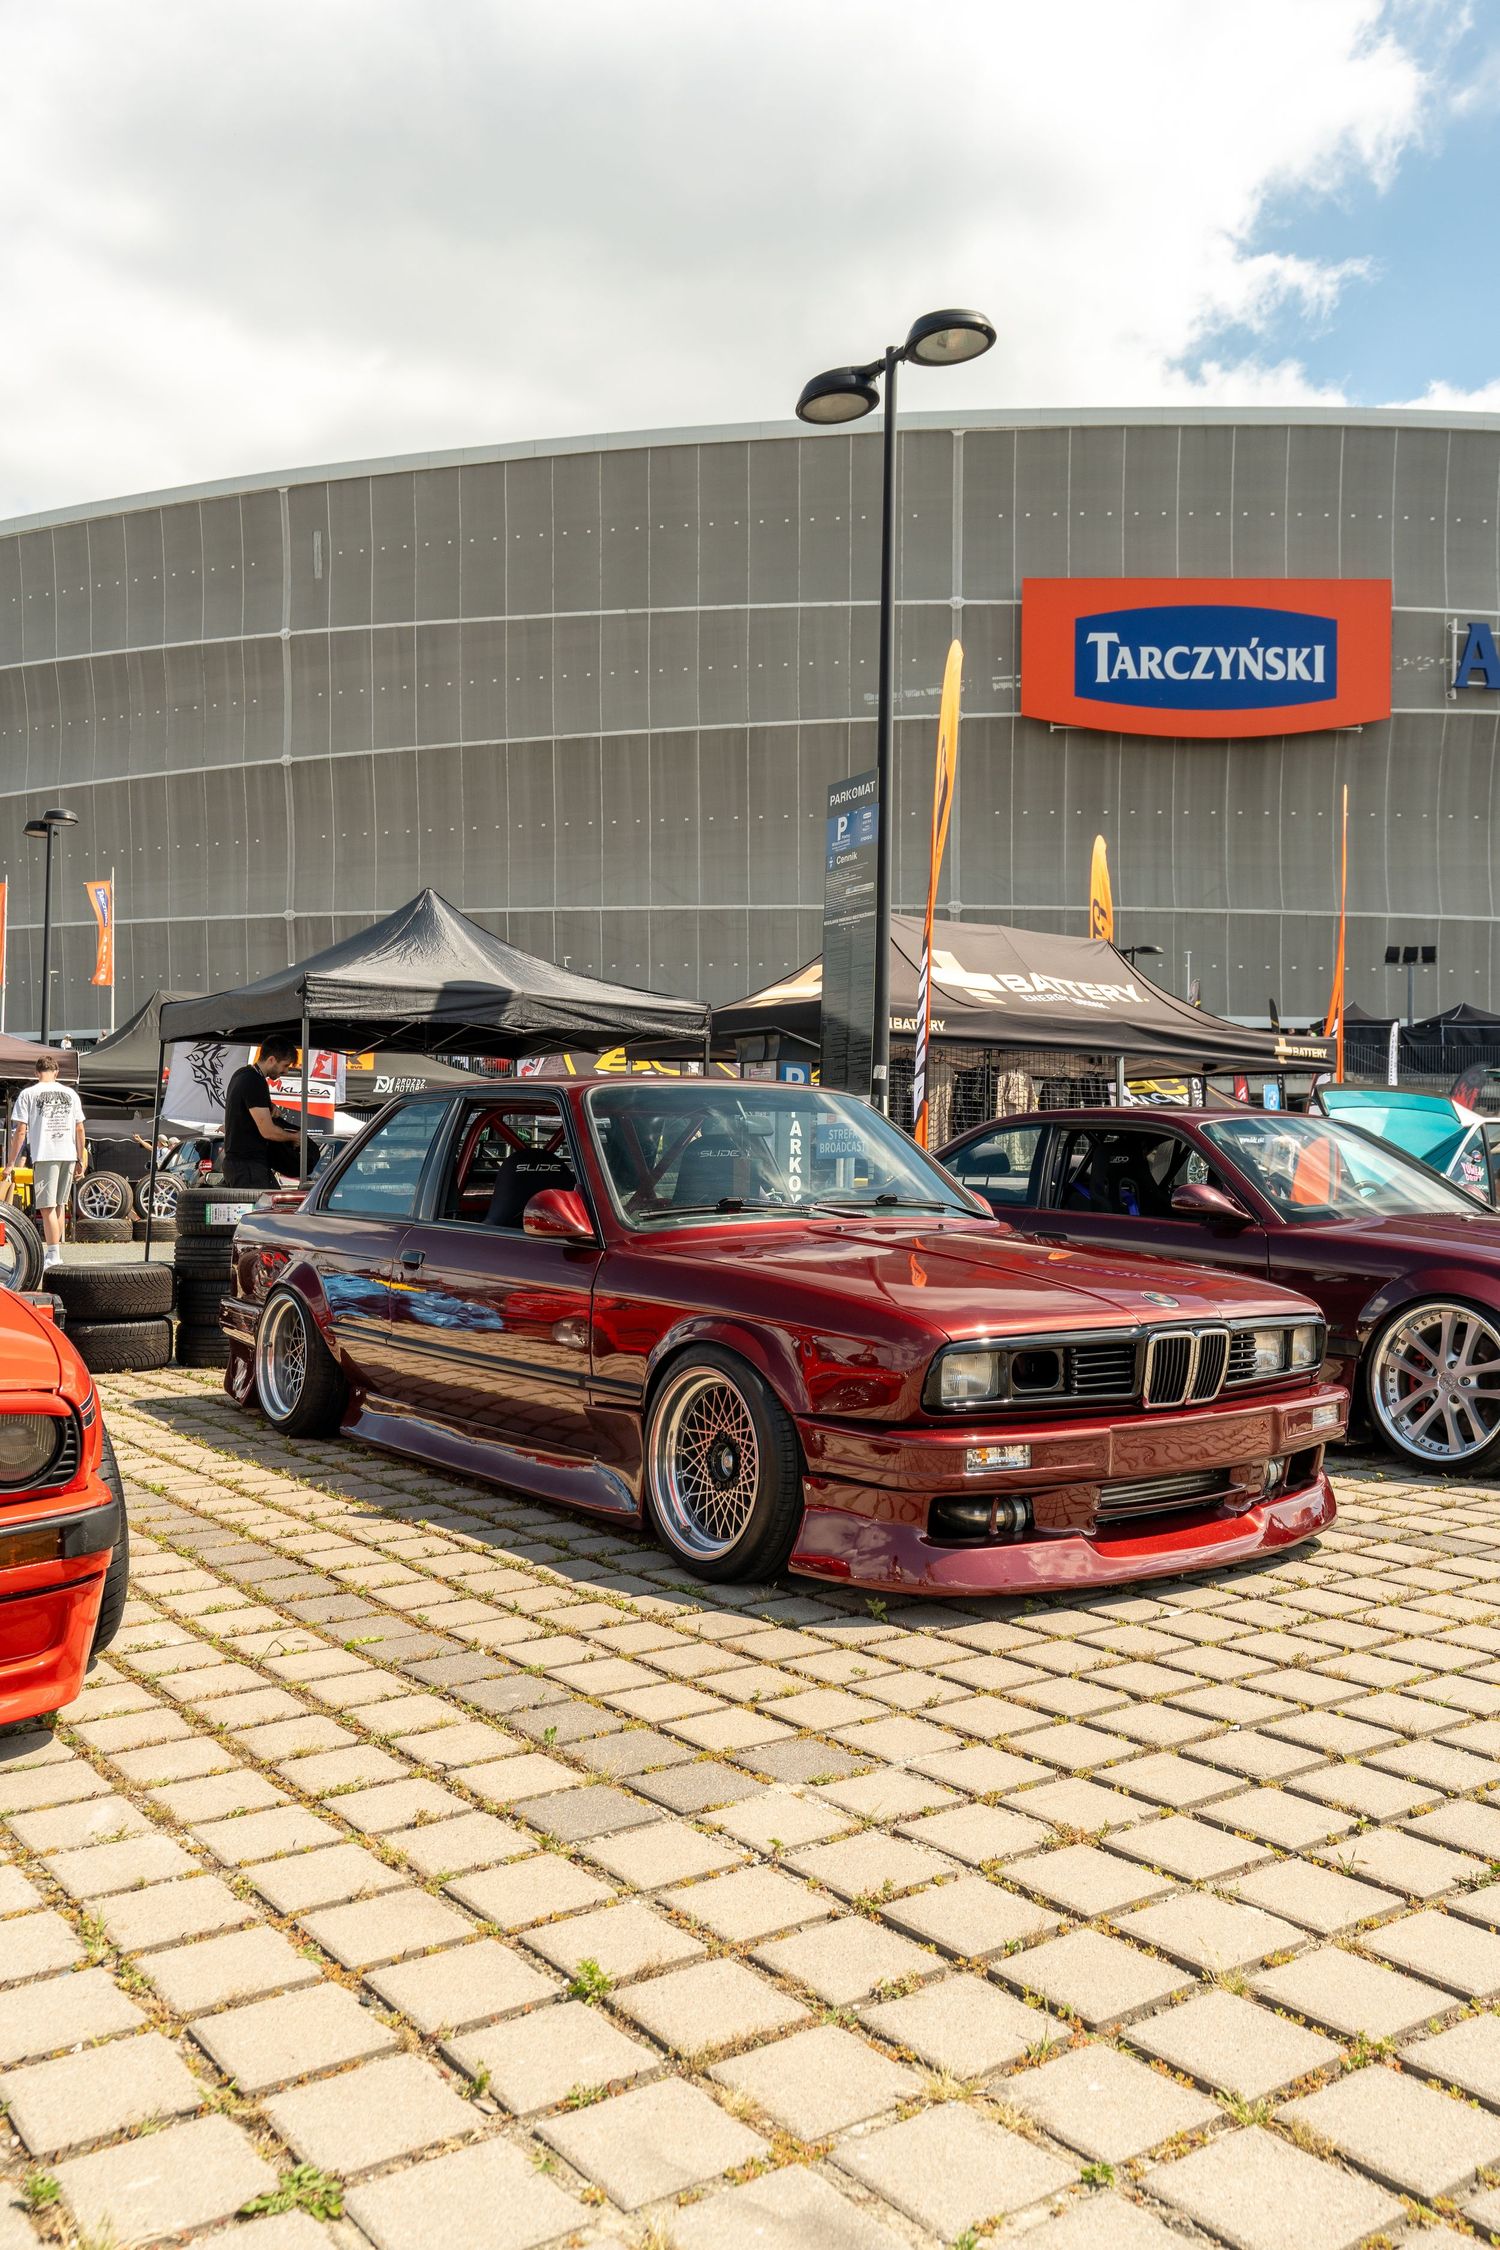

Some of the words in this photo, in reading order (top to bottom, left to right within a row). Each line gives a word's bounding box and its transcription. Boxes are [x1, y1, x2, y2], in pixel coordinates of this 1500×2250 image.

[1086, 633, 1326, 684] TARCZYŃSKI
[829, 780, 876, 807] PARKOMAT
[837, 816, 848, 841] P
[836, 851, 858, 865] Cennik
[1020, 994, 1070, 1003] ENERGY
[280, 1086, 331, 1096] KLSA
[700, 1149, 740, 1157] SLIDE
[819, 1140, 865, 1153] BROADCAST
[788, 1111, 802, 1204] ARKO
[516, 1163, 561, 1172] SLIDE
